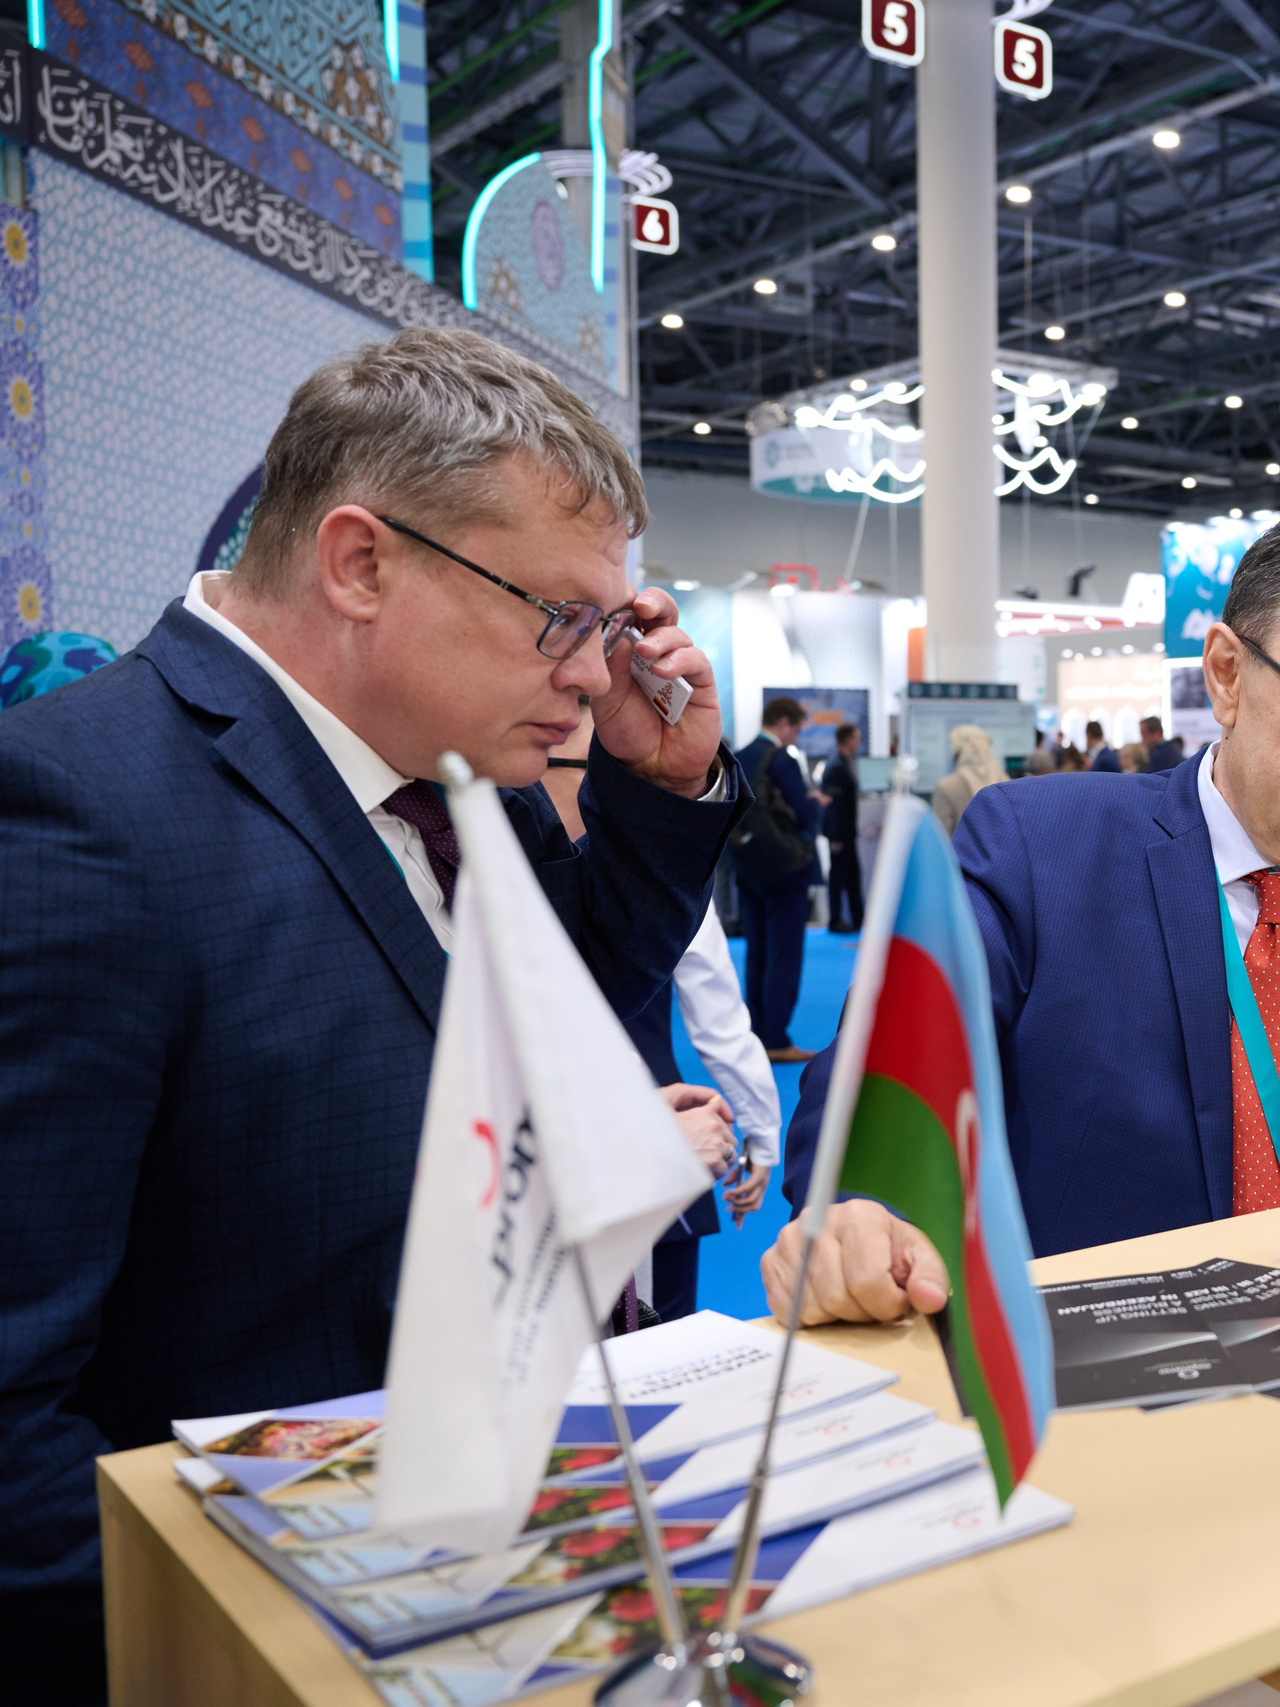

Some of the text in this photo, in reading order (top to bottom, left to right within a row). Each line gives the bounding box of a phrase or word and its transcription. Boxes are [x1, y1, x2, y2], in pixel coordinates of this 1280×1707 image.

[881, 1, 909, 46] 5
[1011, 37, 1038, 81] 5
[641, 209, 664, 241] 6
[1057, 1295, 1157, 1316] AZERBAIJAN
[1092, 1299, 1182, 1317] A BUSINESS
[1095, 1306, 1188, 1324] SETTING UP
